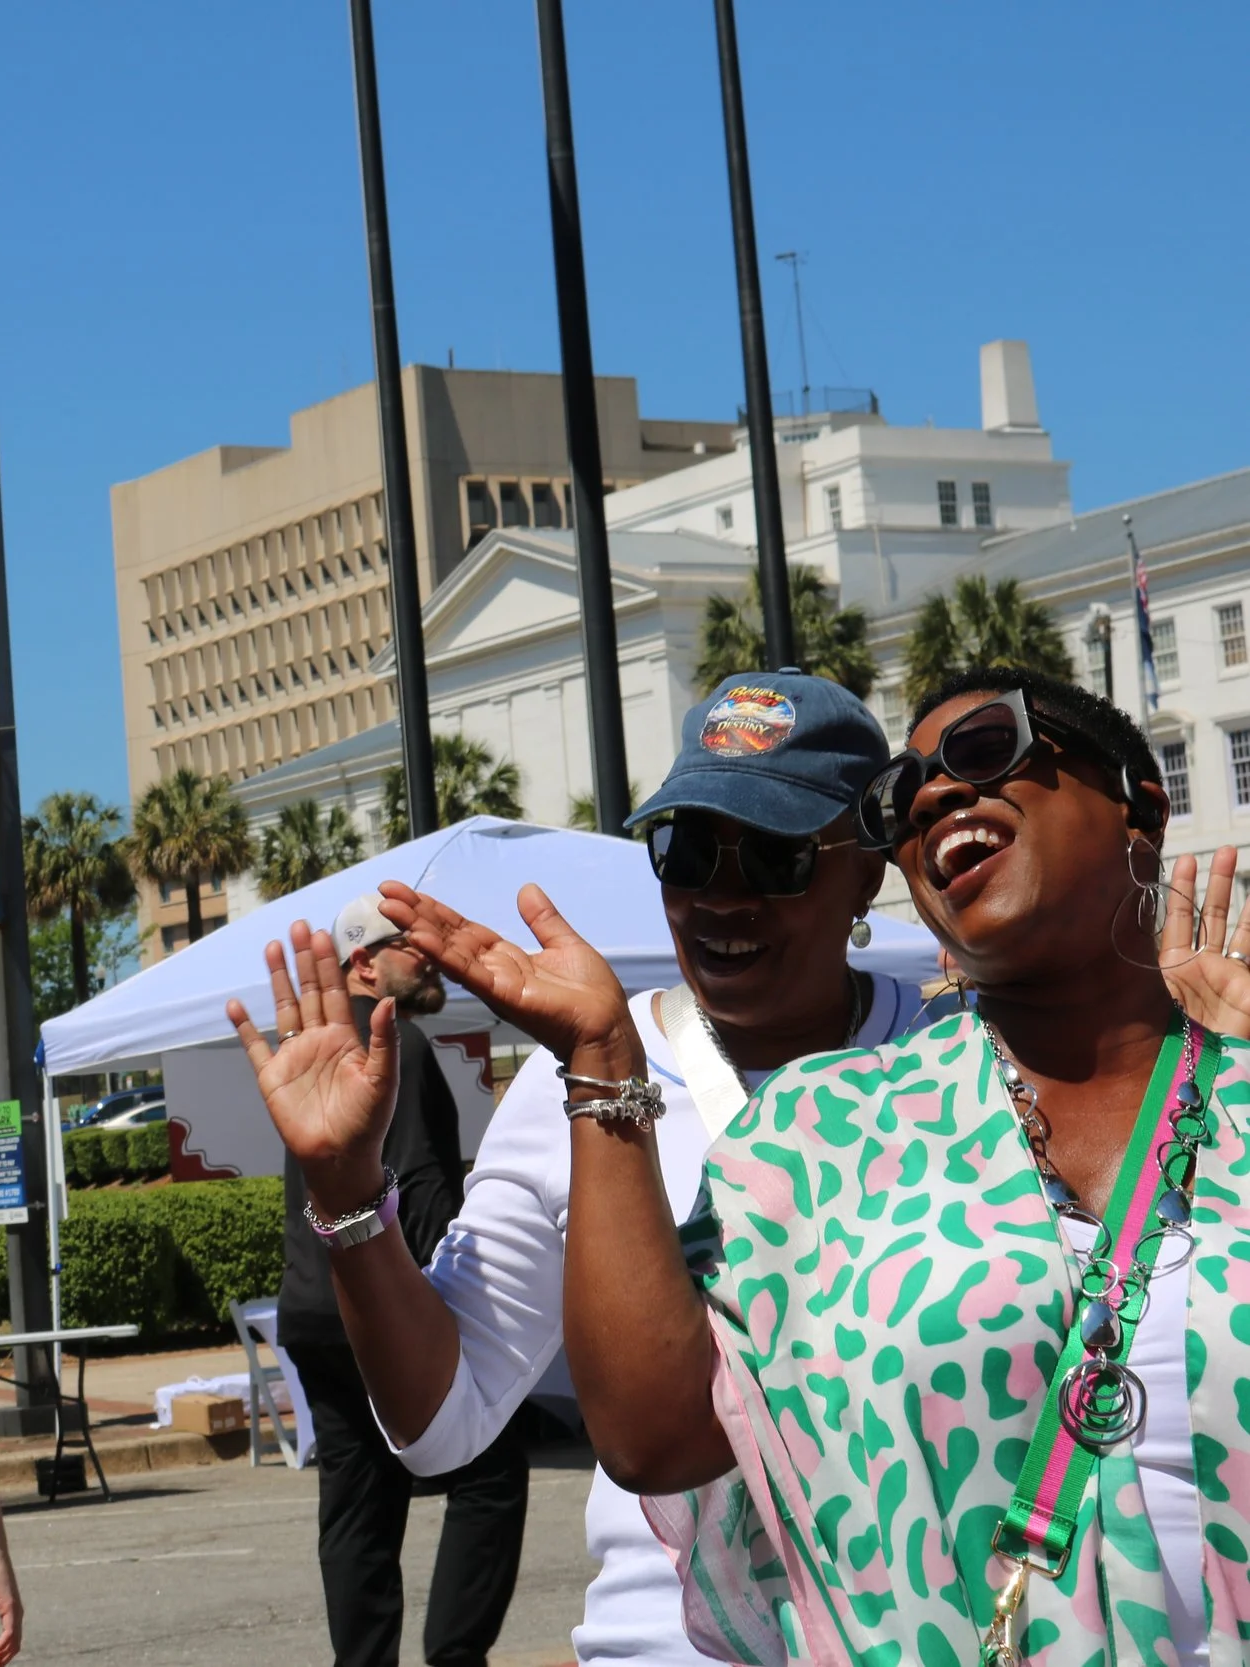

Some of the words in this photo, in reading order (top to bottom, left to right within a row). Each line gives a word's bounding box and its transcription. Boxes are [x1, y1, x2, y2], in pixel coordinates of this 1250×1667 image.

[728, 686, 786, 702] Believe
[716, 722, 770, 736] DESTINY
[0, 1105, 10, 1114] TO
